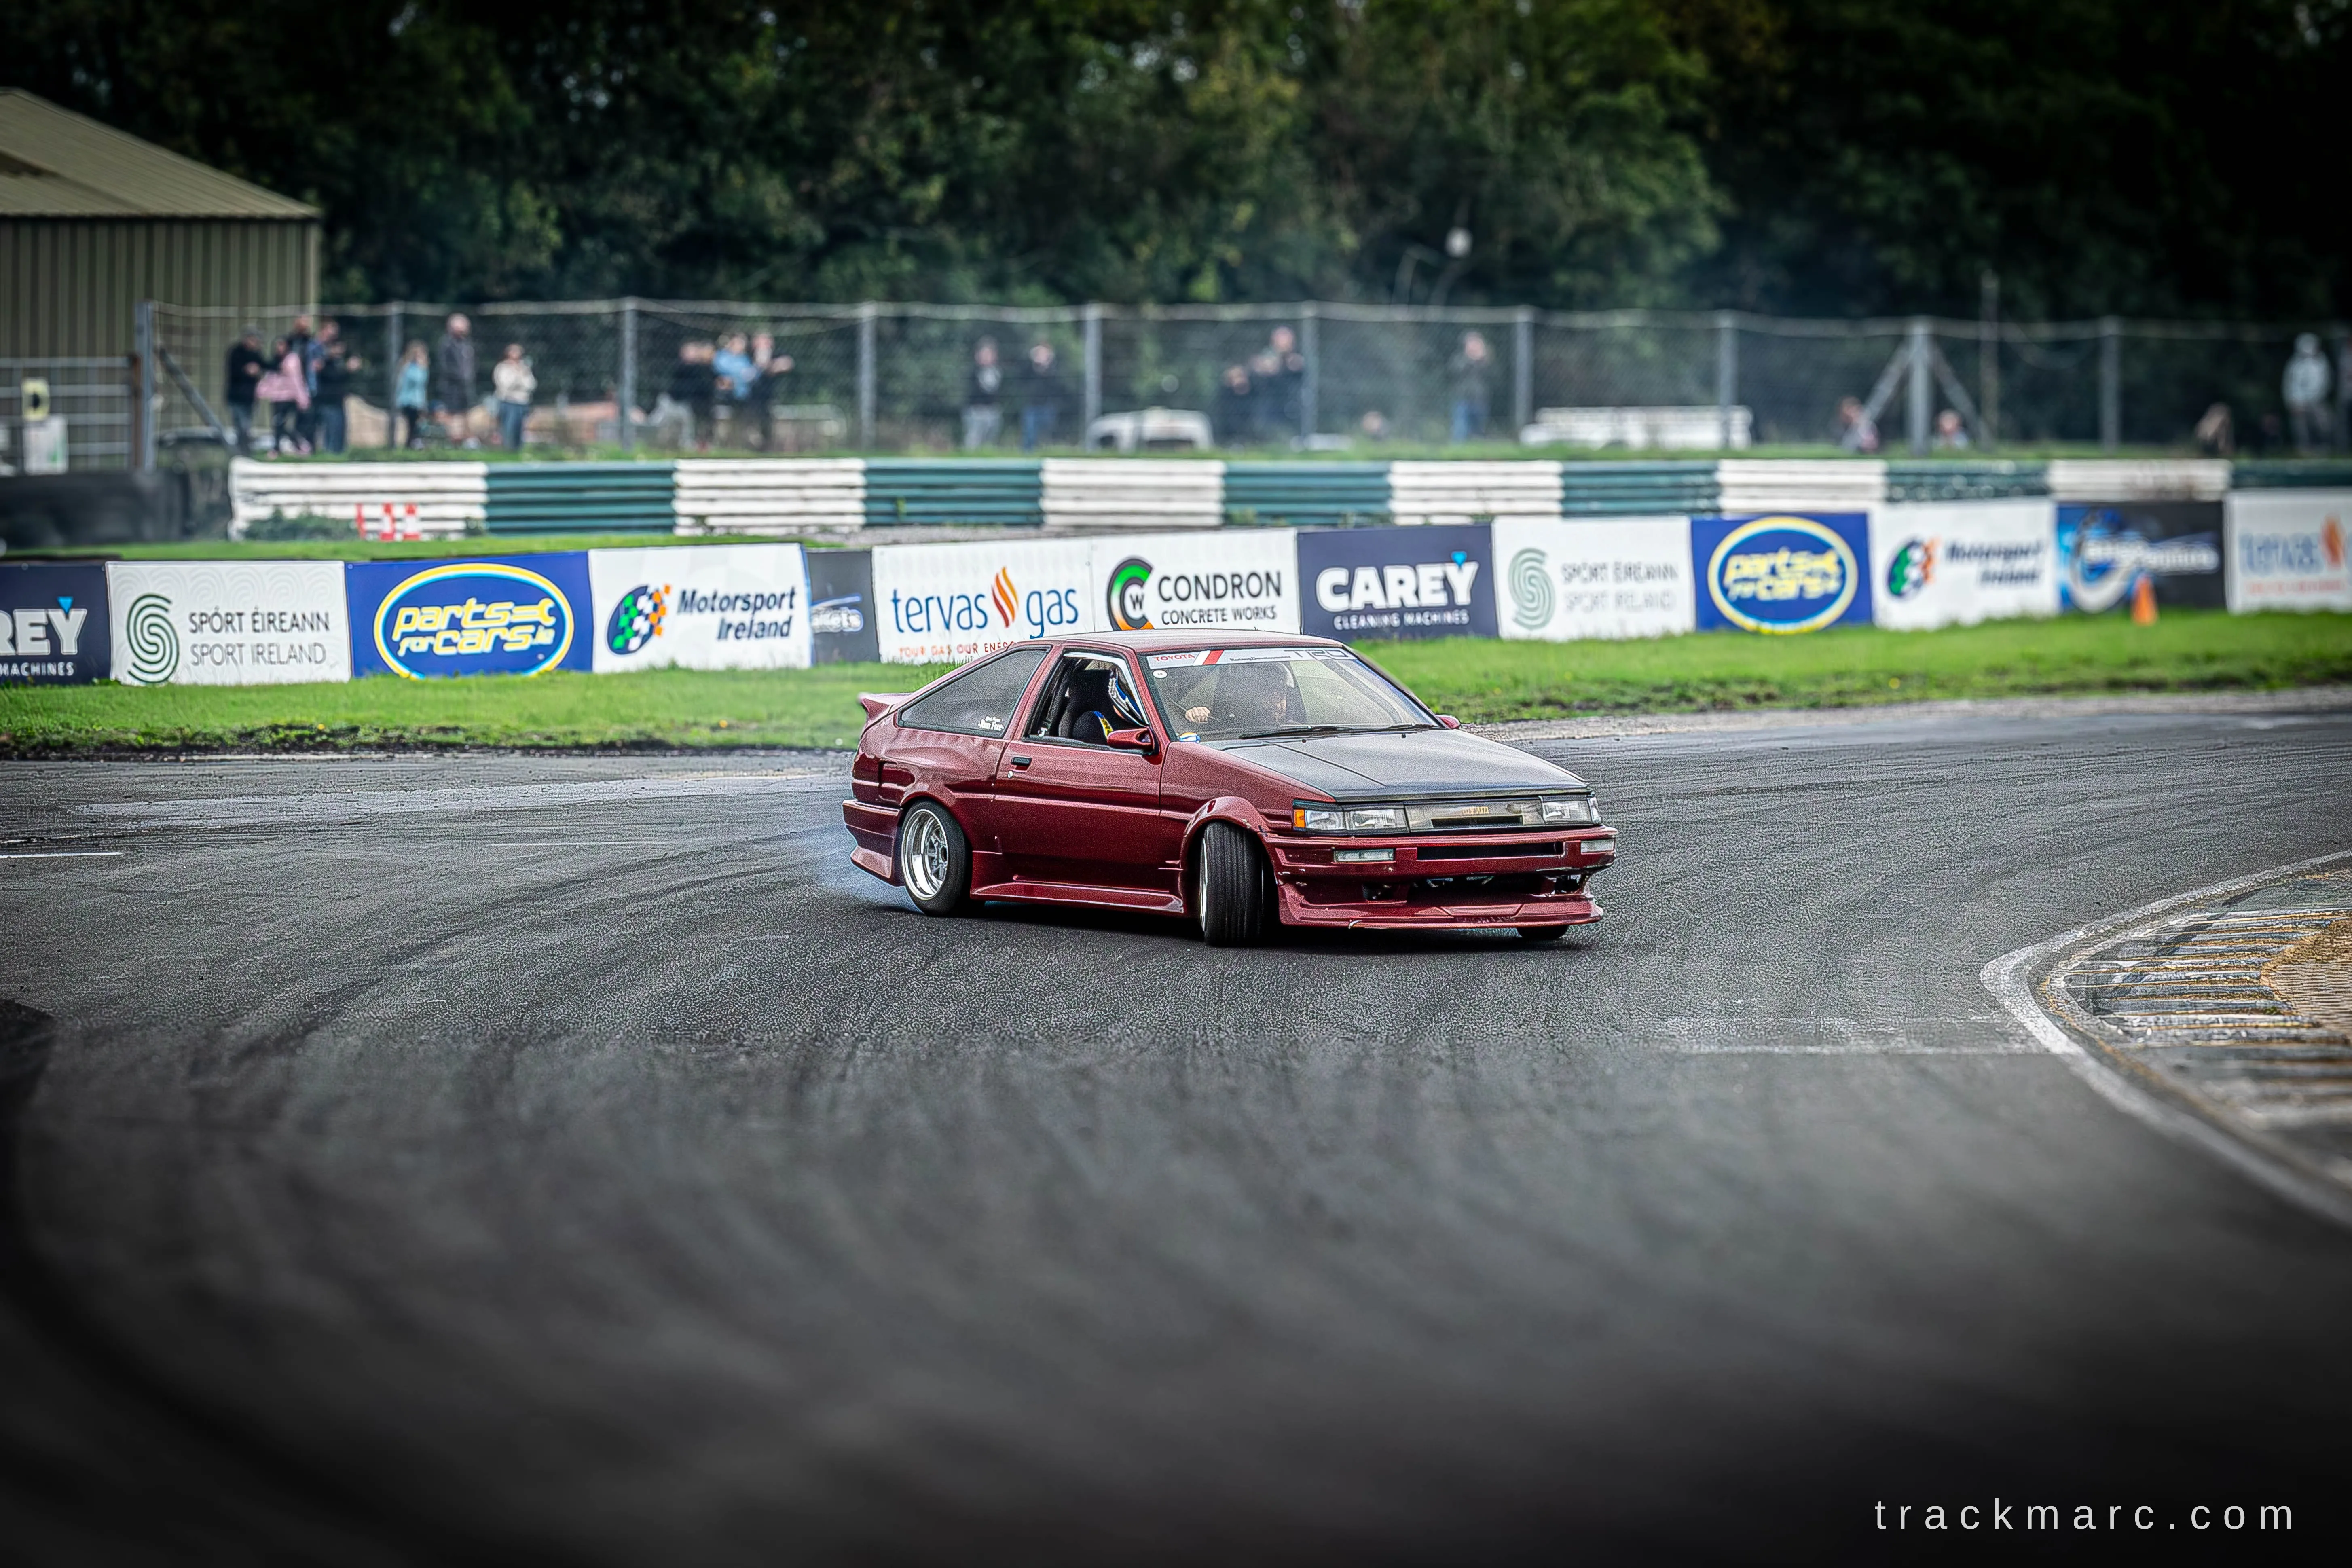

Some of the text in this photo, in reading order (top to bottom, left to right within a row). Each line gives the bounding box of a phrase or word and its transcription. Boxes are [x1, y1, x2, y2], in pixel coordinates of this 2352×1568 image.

[1158, 570, 1281, 601] CONDRON
[1316, 561, 1479, 612] CAREY
[677, 586, 795, 615] Motorsport
[188, 605, 330, 633] SPÓRT ÉIREANN
[392, 598, 514, 641] parts
[890, 589, 1078, 639] tervas gas
[1161, 605, 1277, 625] CONCRETE WORKS
[1335, 609, 1469, 630] CLEANING MACHINES
[717, 615, 792, 640] Ireland
[190, 642, 327, 667] SPORT IRELAND
[397, 636, 435, 656] for
[899, 646, 926, 657] YOUR
[931, 645, 951, 655] GAS
[956, 643, 978, 654] OUR
[1154, 654, 1195, 662] TOYOTA
